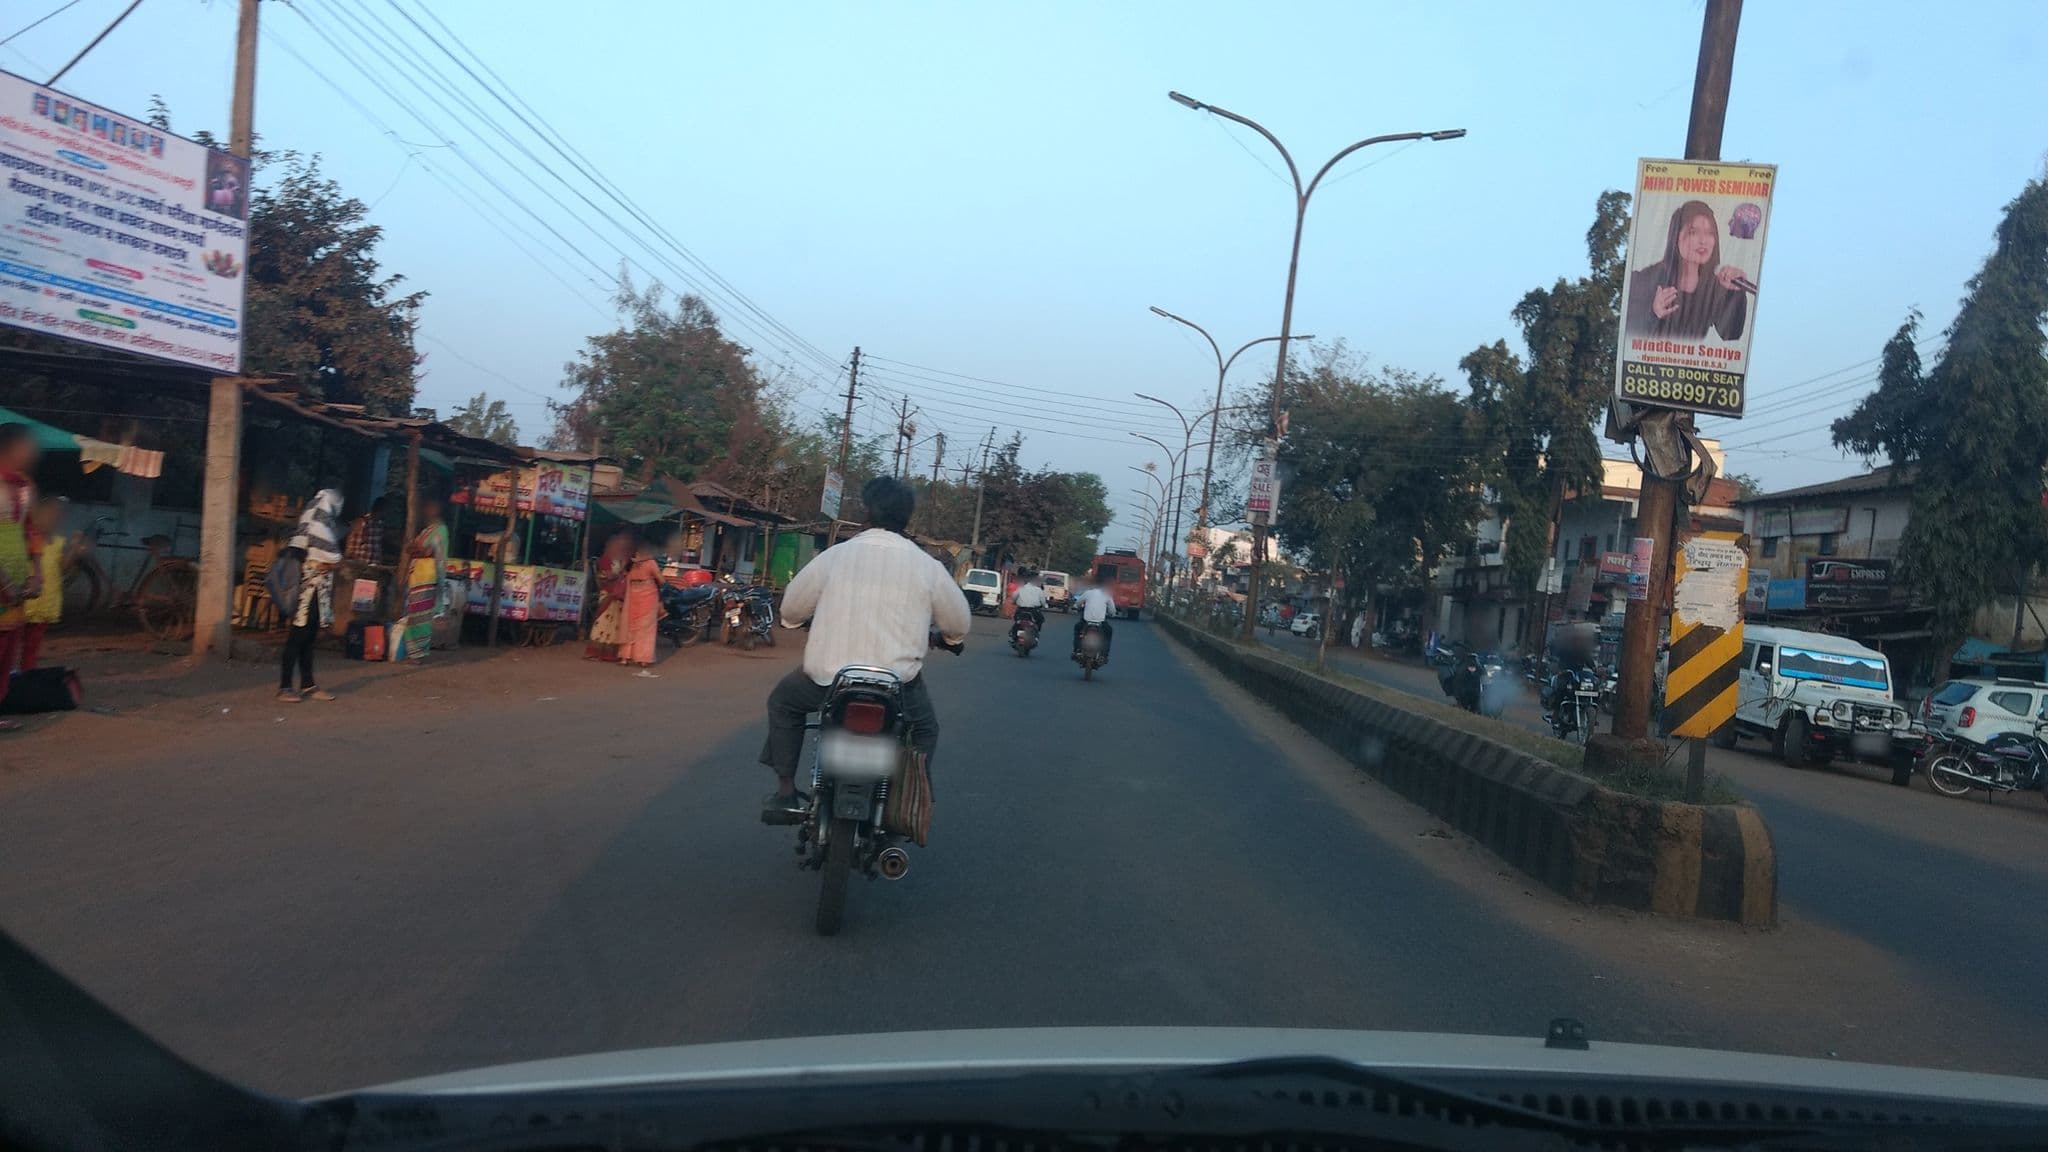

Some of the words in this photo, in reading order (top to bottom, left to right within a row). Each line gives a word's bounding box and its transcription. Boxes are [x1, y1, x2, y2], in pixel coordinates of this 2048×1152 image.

[1646, 164, 1668, 173] Free
[1697, 167, 1720, 176] Free
[1749, 170, 1772, 178] Free
[1644, 176, 1674, 192] MIND
[1676, 178, 1716, 194] POWER
[1718, 180, 1770, 197] SEMINAR
[1632, 338, 1695, 356] MindGuru
[1698, 344, 1742, 361] Soniya
[1642, 354, 1700, 366] Hypnotherapist
[1628, 363, 1656, 376] CALL
[1660, 367, 1674, 378] TO
[1678, 369, 1710, 382] BOOK
[1712, 373, 1740, 386] SEAT
[1624, 376, 1740, 408] 8888899730
[1851, 568, 1886, 580] EXPRESS
